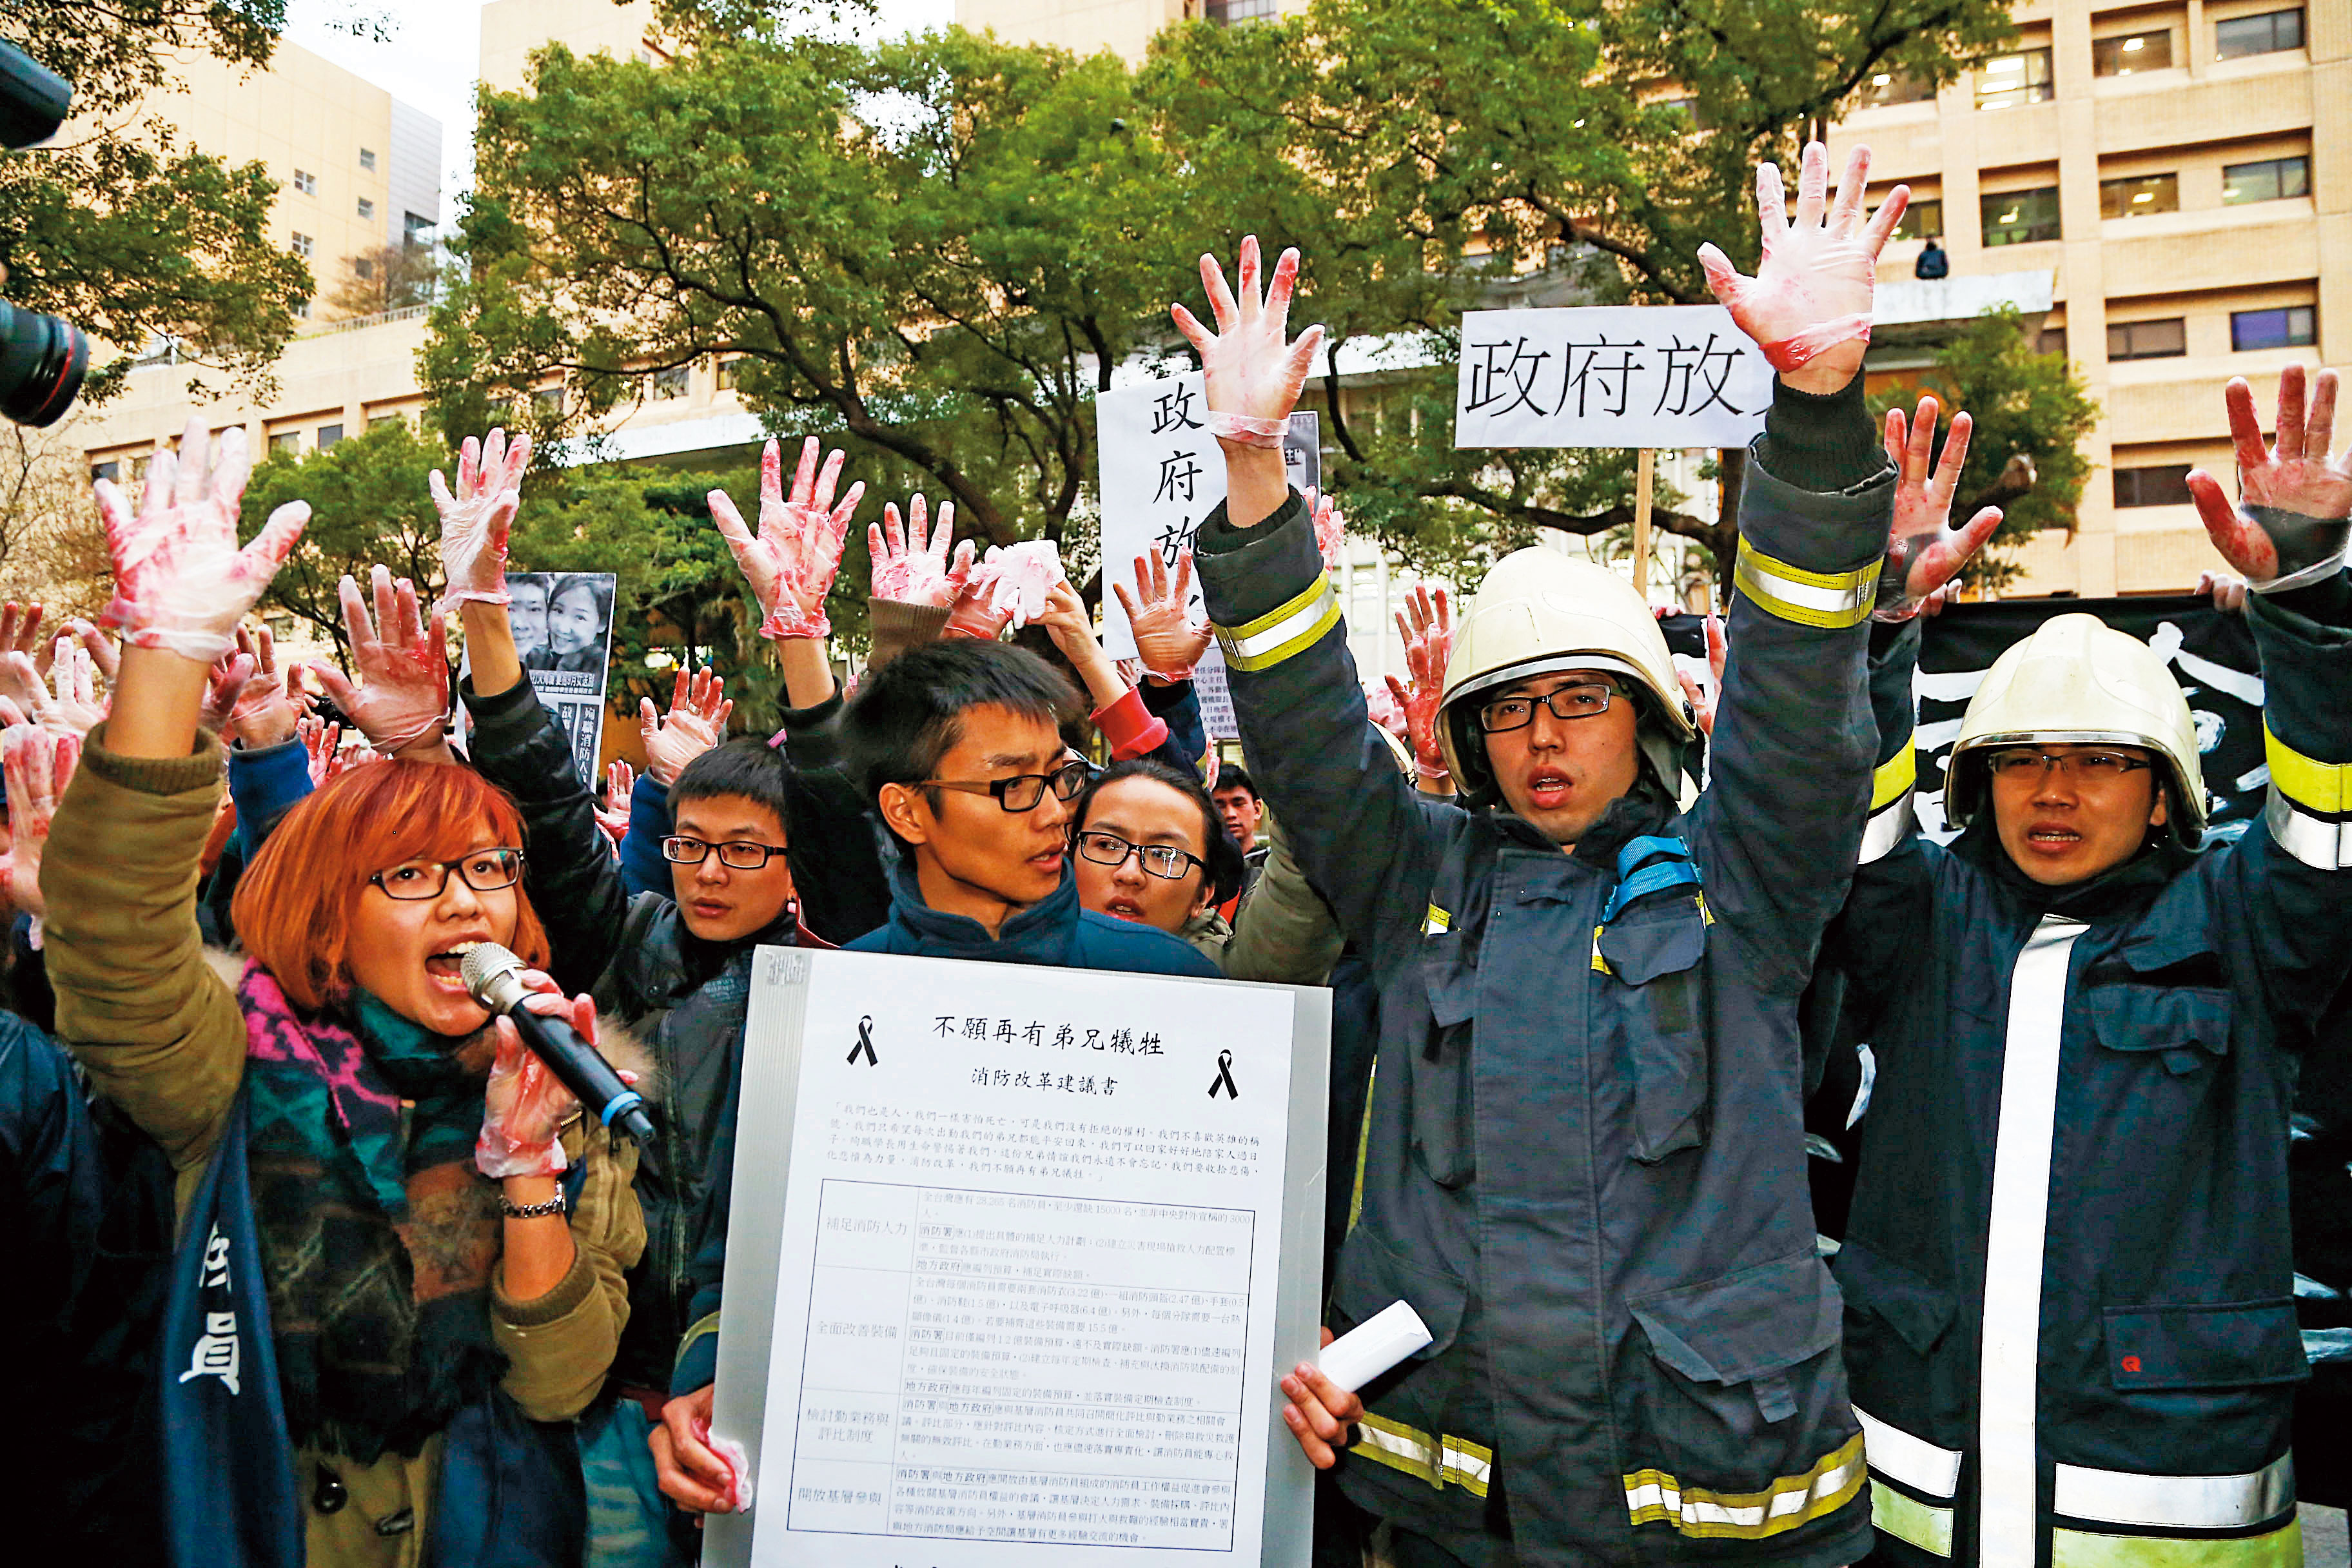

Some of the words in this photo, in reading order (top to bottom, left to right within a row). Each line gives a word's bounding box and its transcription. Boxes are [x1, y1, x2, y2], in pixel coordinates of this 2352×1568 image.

[1465, 333, 1767, 417] 政府放
[1151, 382, 1204, 626] 政府放
[578, 707, 595, 783] 殉職消防人
[932, 1016, 1164, 1056] 不願再有弟兄犧牲
[971, 1066, 1119, 1096] 消防改革建議書
[826, 1216, 907, 1235] 補足消防人力
[816, 1320, 897, 1339] 全面改善裝備
[805, 1407, 889, 1426] 檢討勤業務與
[818, 1426, 874, 1443] 評比制度
[798, 1487, 882, 1505] 開放基層參與
